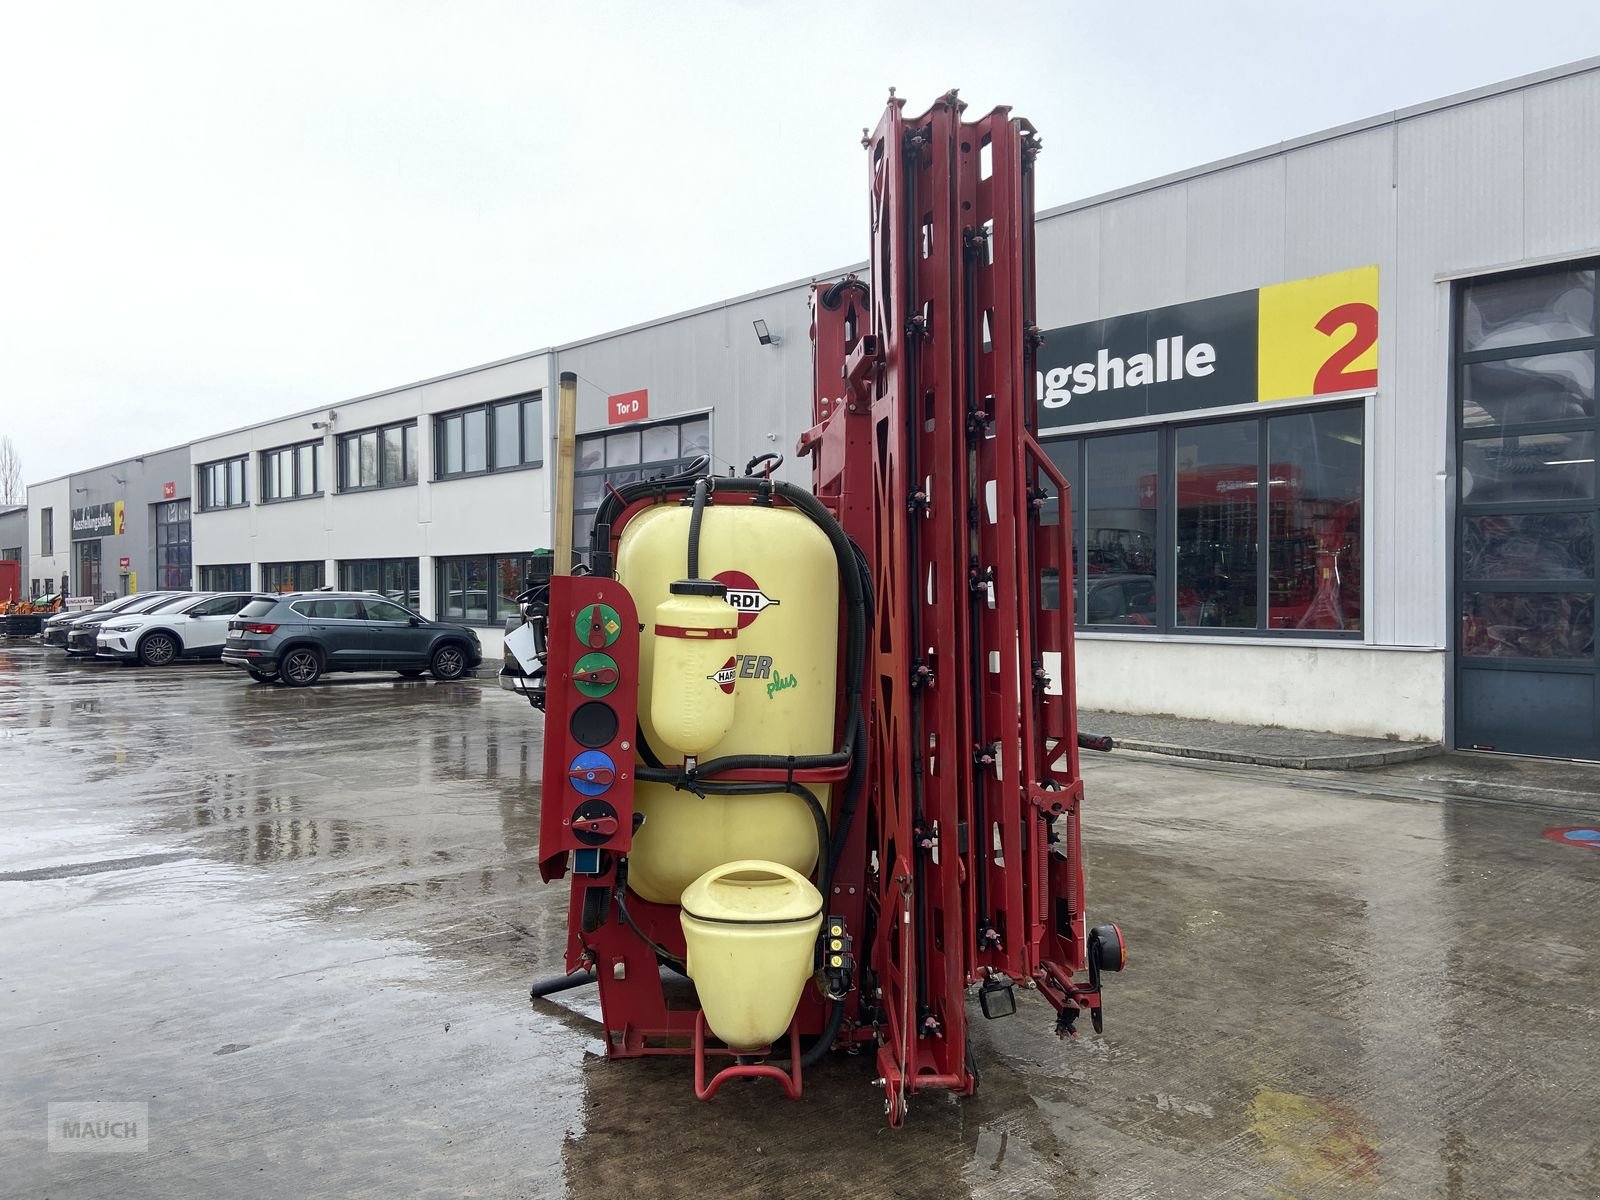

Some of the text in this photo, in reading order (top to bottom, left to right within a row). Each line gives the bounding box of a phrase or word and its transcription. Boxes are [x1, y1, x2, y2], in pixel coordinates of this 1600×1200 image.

[1313, 302, 1379, 395] 2
[616, 400, 639, 415] Tor D
[119, 510, 125, 535] 2
[723, 593, 760, 608] RDI
[767, 669, 798, 700] plus
